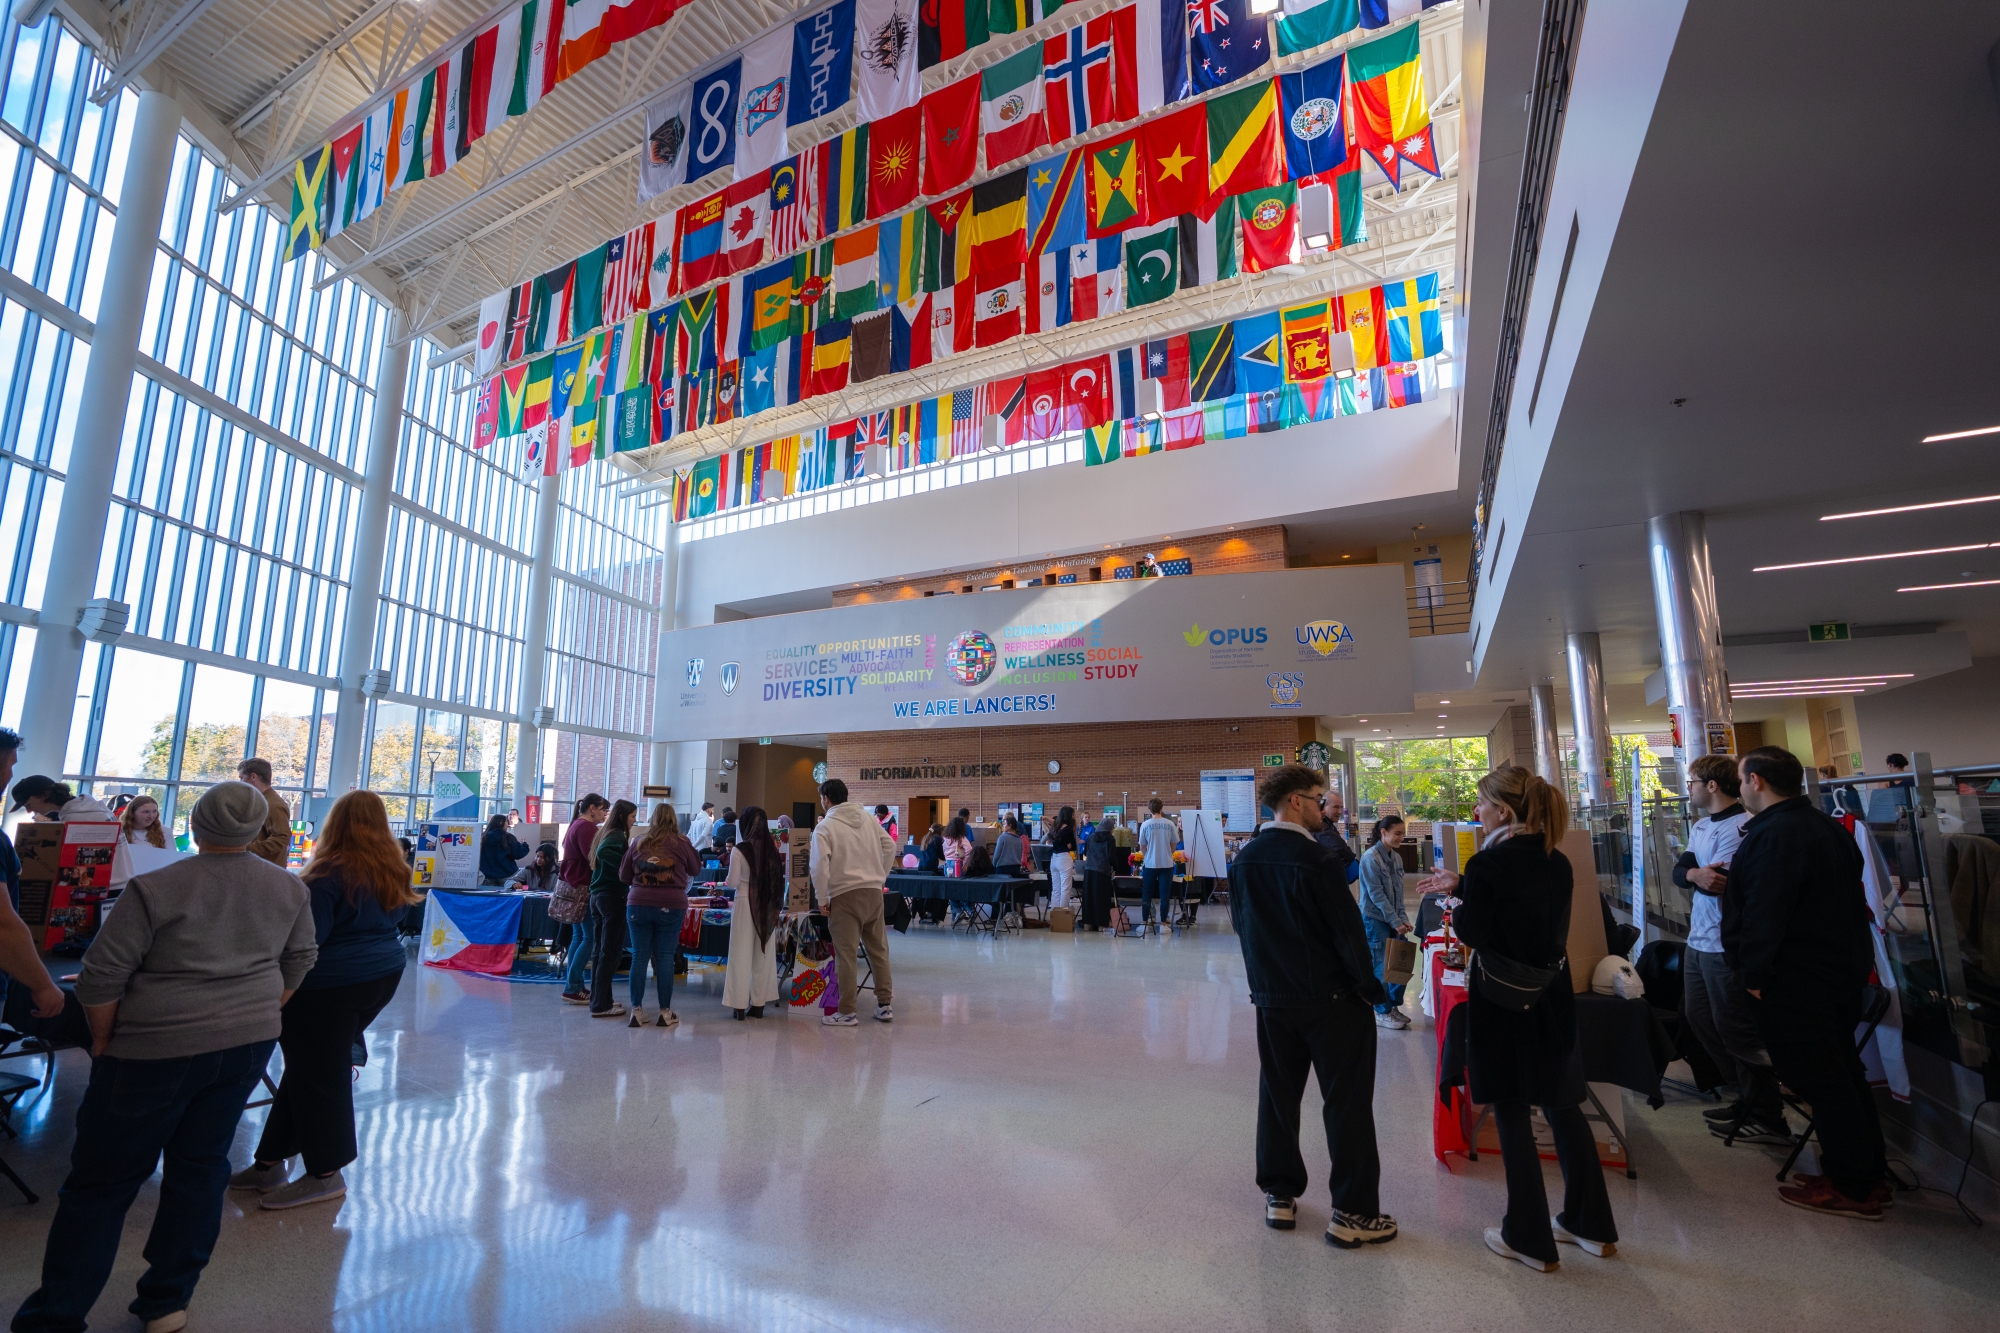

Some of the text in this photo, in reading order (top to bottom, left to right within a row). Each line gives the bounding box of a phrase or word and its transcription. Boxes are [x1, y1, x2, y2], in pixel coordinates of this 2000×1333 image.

[966, 556, 1096, 582] Excellence in Teaching & Mentoring
[1004, 620, 1086, 639] COMMUNITY
[1091, 619, 1103, 647] FUN
[1209, 626, 1268, 646] OPUS
[1295, 624, 1354, 644] UWSA
[765, 634, 922, 661] EQUALITY OPPORTUNITIES
[924, 633, 937, 668] DINE
[1004, 637, 1085, 653] REPRESENTATION
[764, 647, 914, 680] SERVICES MULTI-FAITH
[849, 660, 905, 674] ADVOCACY
[1004, 646, 1143, 670] WELLNESS SOCIAL
[763, 669, 934, 701] DIVERSITY SOLIDARITY
[998, 663, 1139, 686] INCLUSION STUDY
[1266, 671, 1304, 689] GSS
[893, 694, 1056, 718] WE ARE LANCERS!
[860, 763, 1002, 780] INFORMATION DESK
[453, 834, 472, 846] FSA
